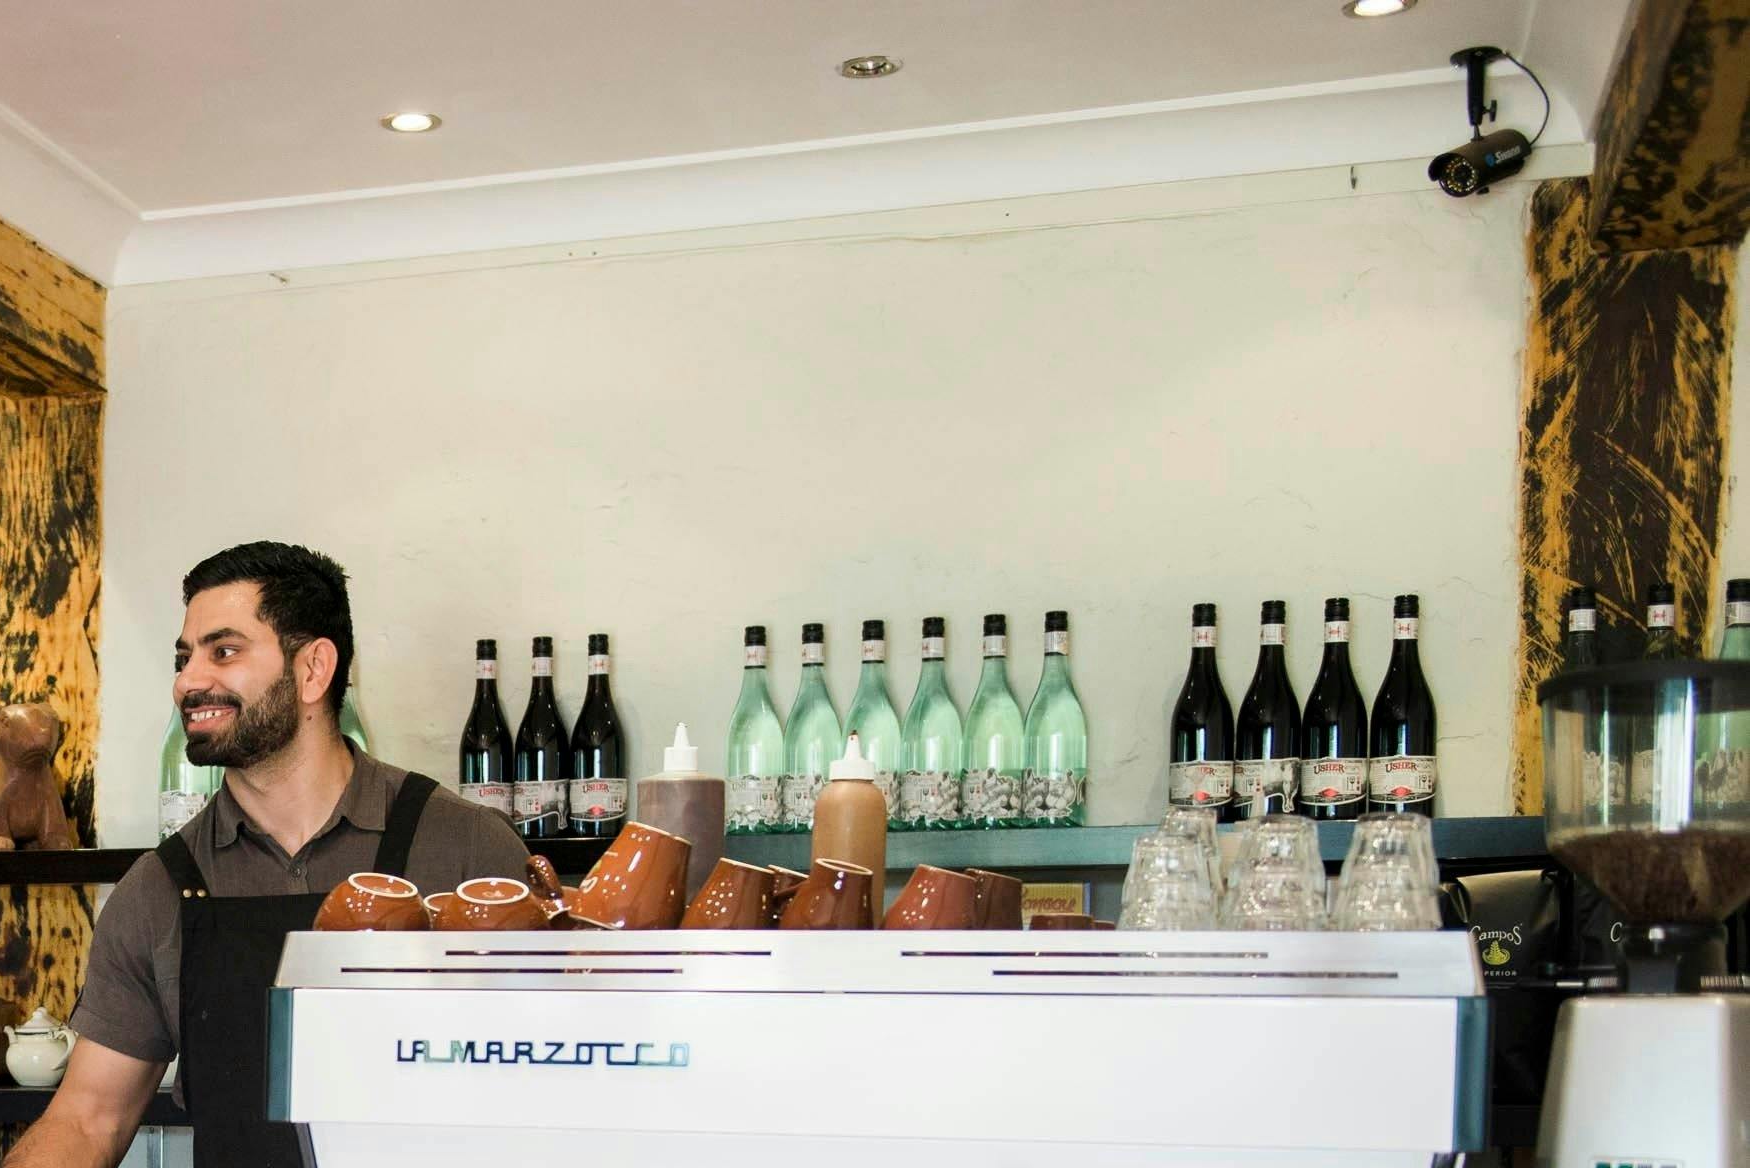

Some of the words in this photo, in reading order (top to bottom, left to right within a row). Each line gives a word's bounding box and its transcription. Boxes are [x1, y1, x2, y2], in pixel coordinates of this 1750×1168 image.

[1313, 762, 1346, 775] USHER
[1385, 761, 1418, 774] USHER
[582, 783, 610, 794] USHER
